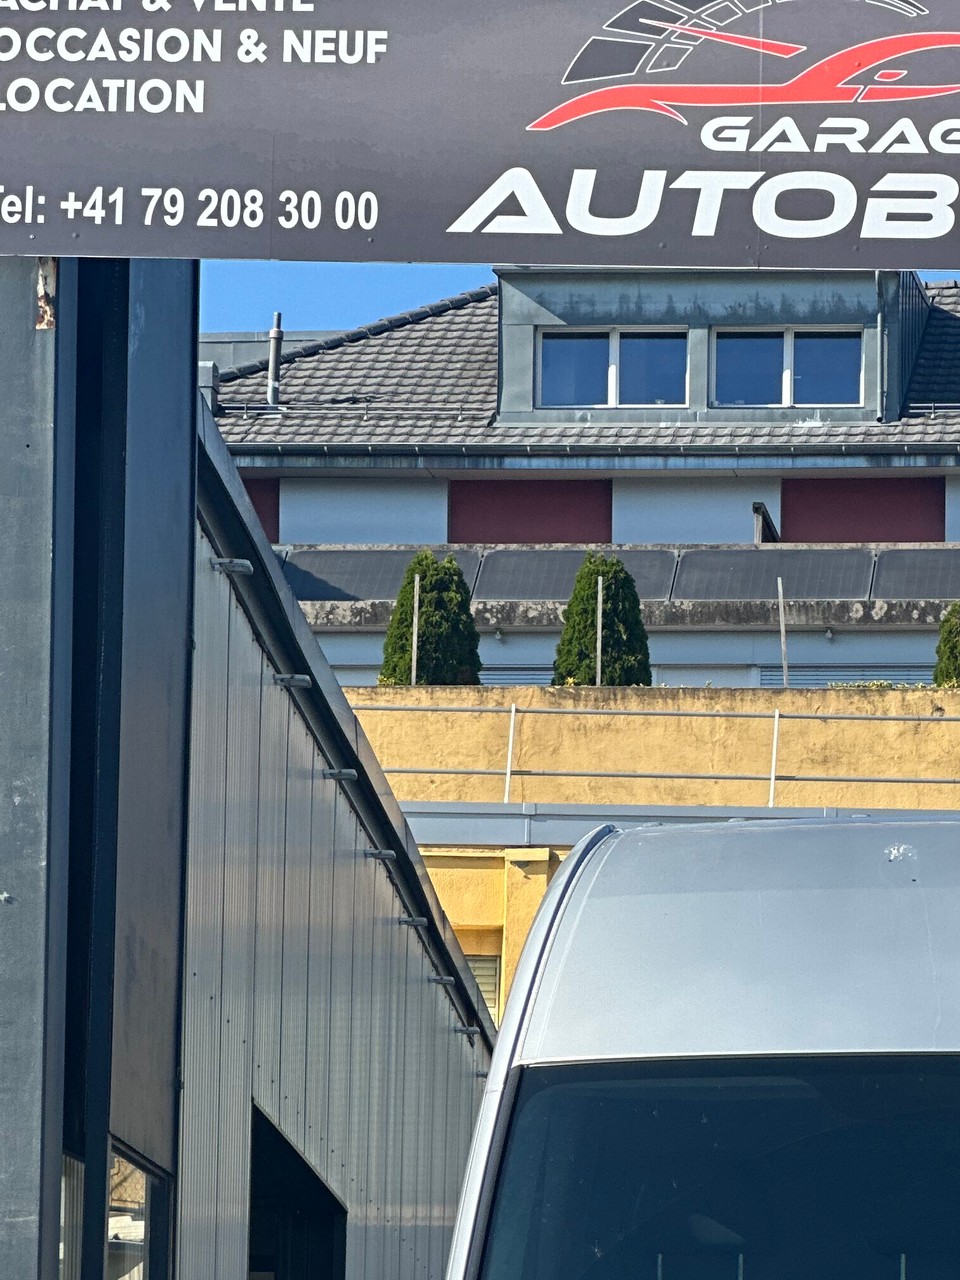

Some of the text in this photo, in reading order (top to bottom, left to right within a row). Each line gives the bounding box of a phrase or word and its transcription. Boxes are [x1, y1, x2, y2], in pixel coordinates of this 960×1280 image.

[0, 27, 389, 65] OCCASION & NEUF
[0, 78, 205, 114] OCATION
[0, 184, 379, 231] el: +41 79 208 30 00
